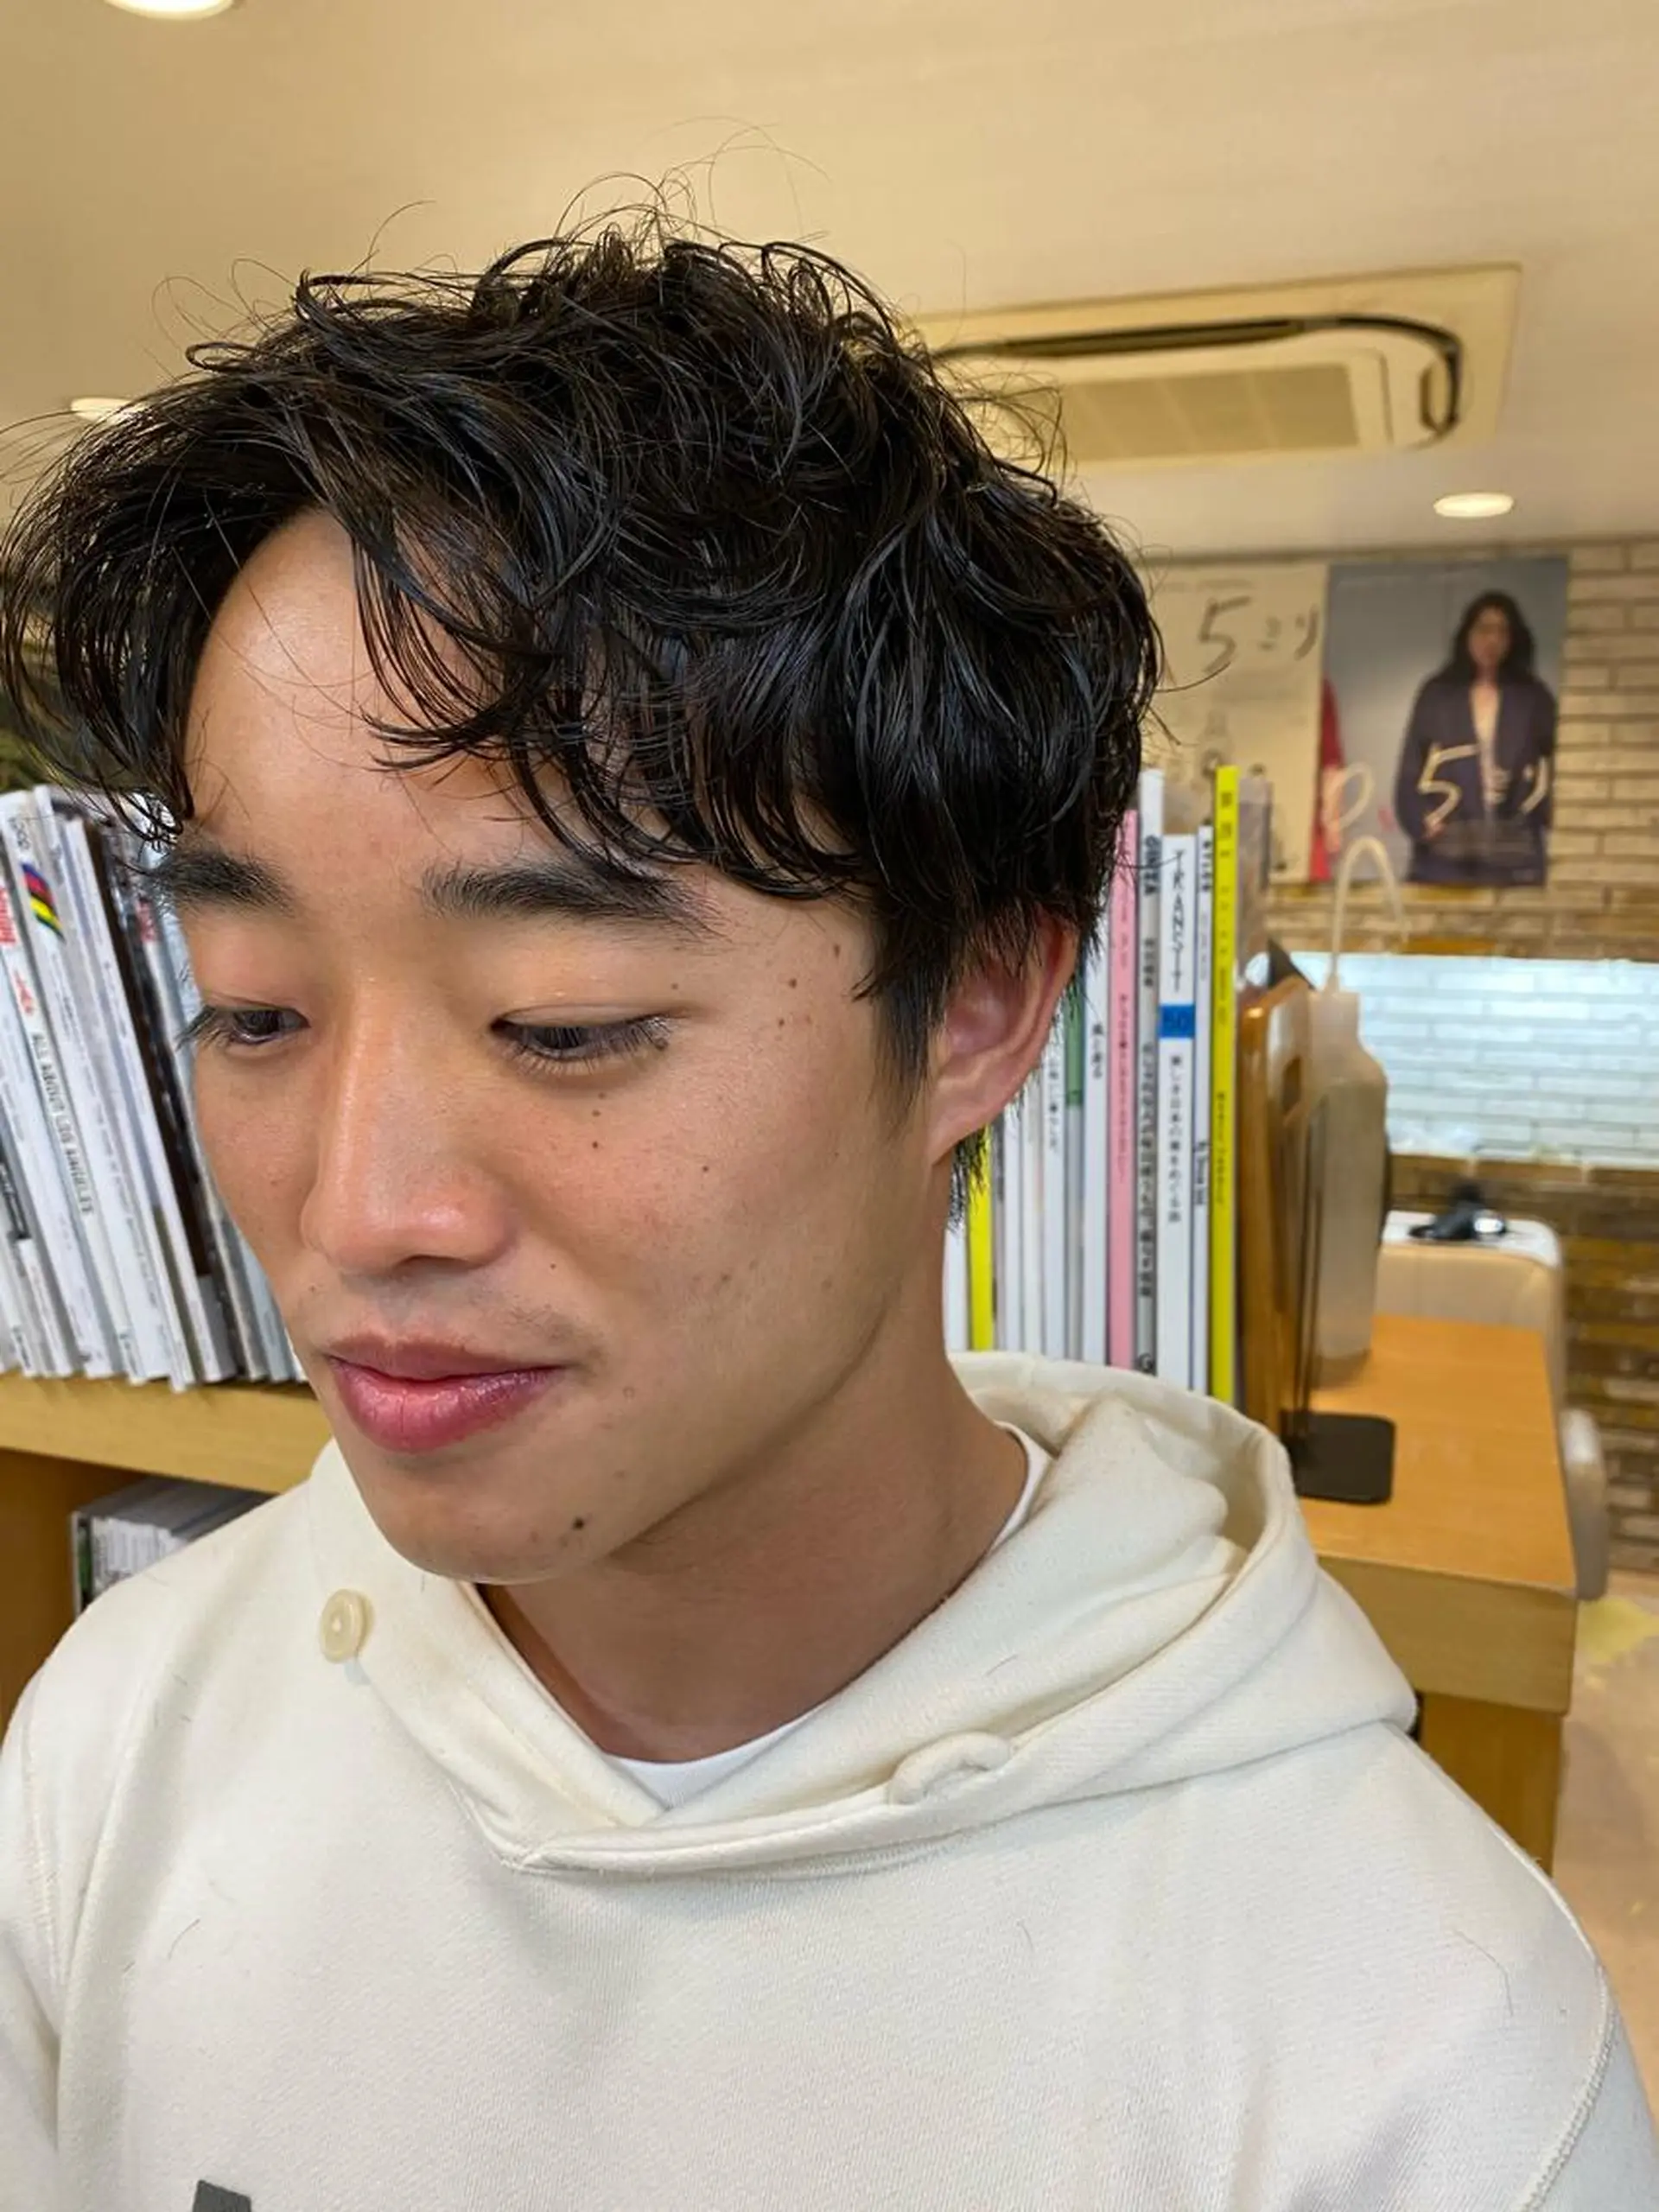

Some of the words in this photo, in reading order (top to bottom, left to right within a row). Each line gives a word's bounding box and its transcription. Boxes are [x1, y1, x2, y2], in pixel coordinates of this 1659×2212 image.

[1143, 835, 1161, 896] GINZA
[1170, 849, 1186, 992] TRANSIT
[32, 1033, 49, 1058] ALL
[41, 1062, 65, 1113] ABOUT
[56, 1114, 74, 1143] LOS
[65, 1147, 94, 1214] ANGELES
